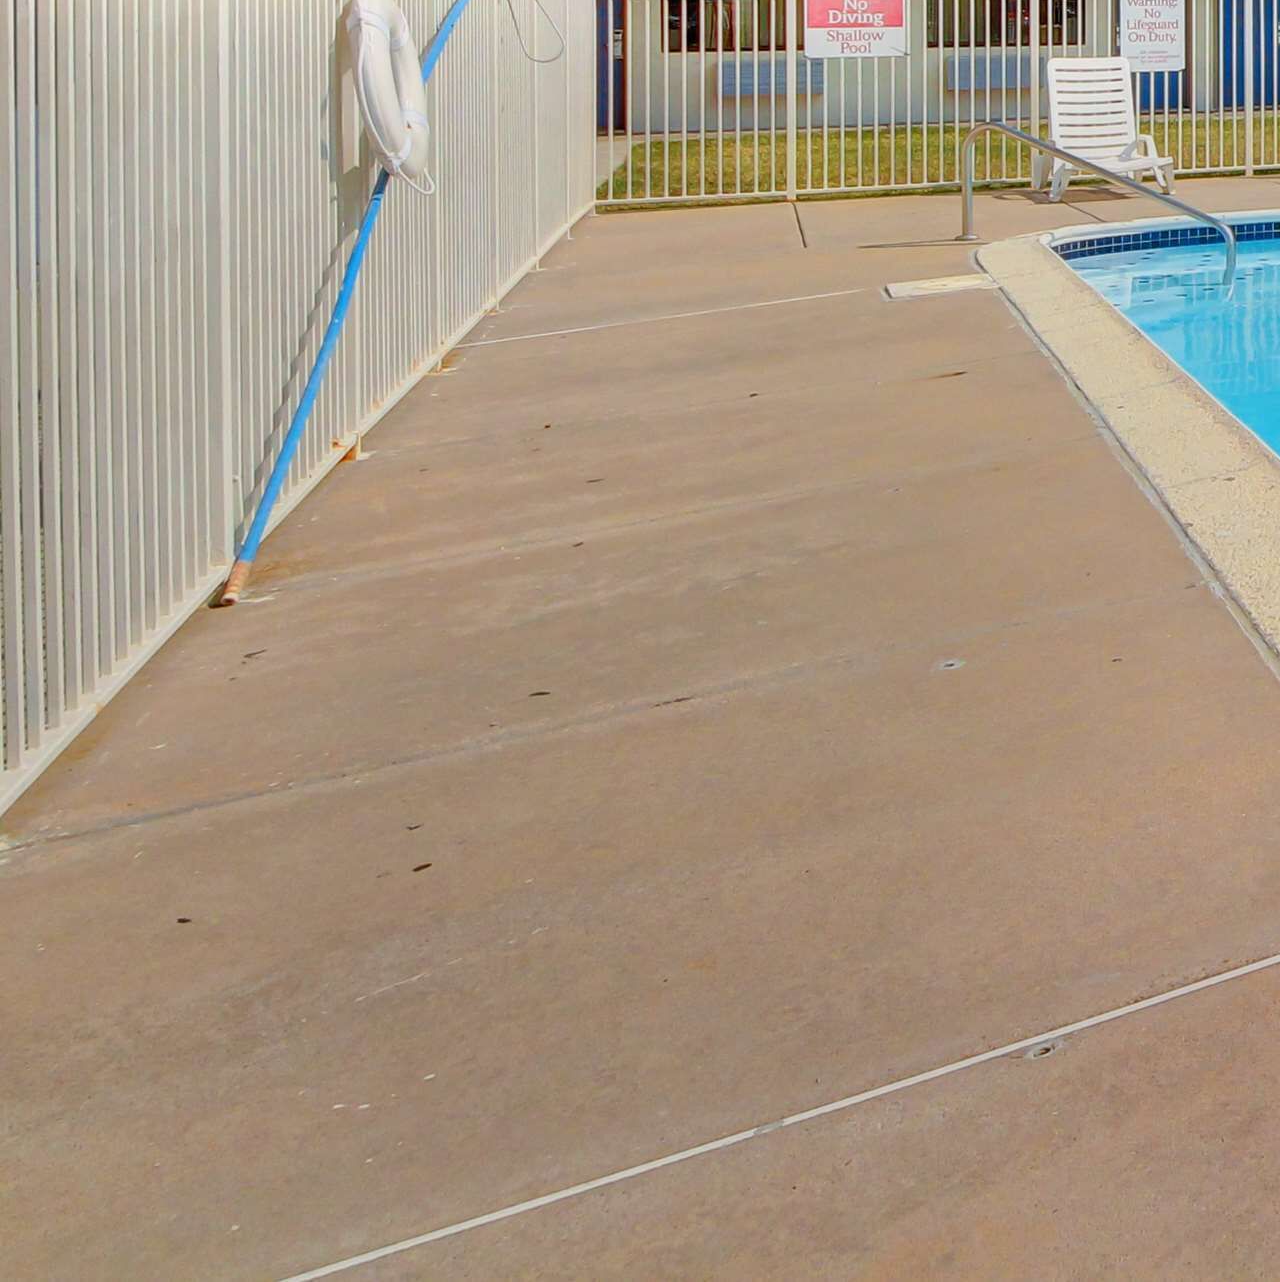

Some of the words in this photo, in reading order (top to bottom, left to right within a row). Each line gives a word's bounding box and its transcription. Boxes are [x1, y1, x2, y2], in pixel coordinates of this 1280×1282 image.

[828, 10, 885, 26] Diving
[1144, 8, 1161, 18] No
[1127, 19, 1179, 32] Lifeguard
[826, 29, 885, 42] Shallow
[1128, 31, 1146, 43] On
[841, 42, 872, 54] Pool
